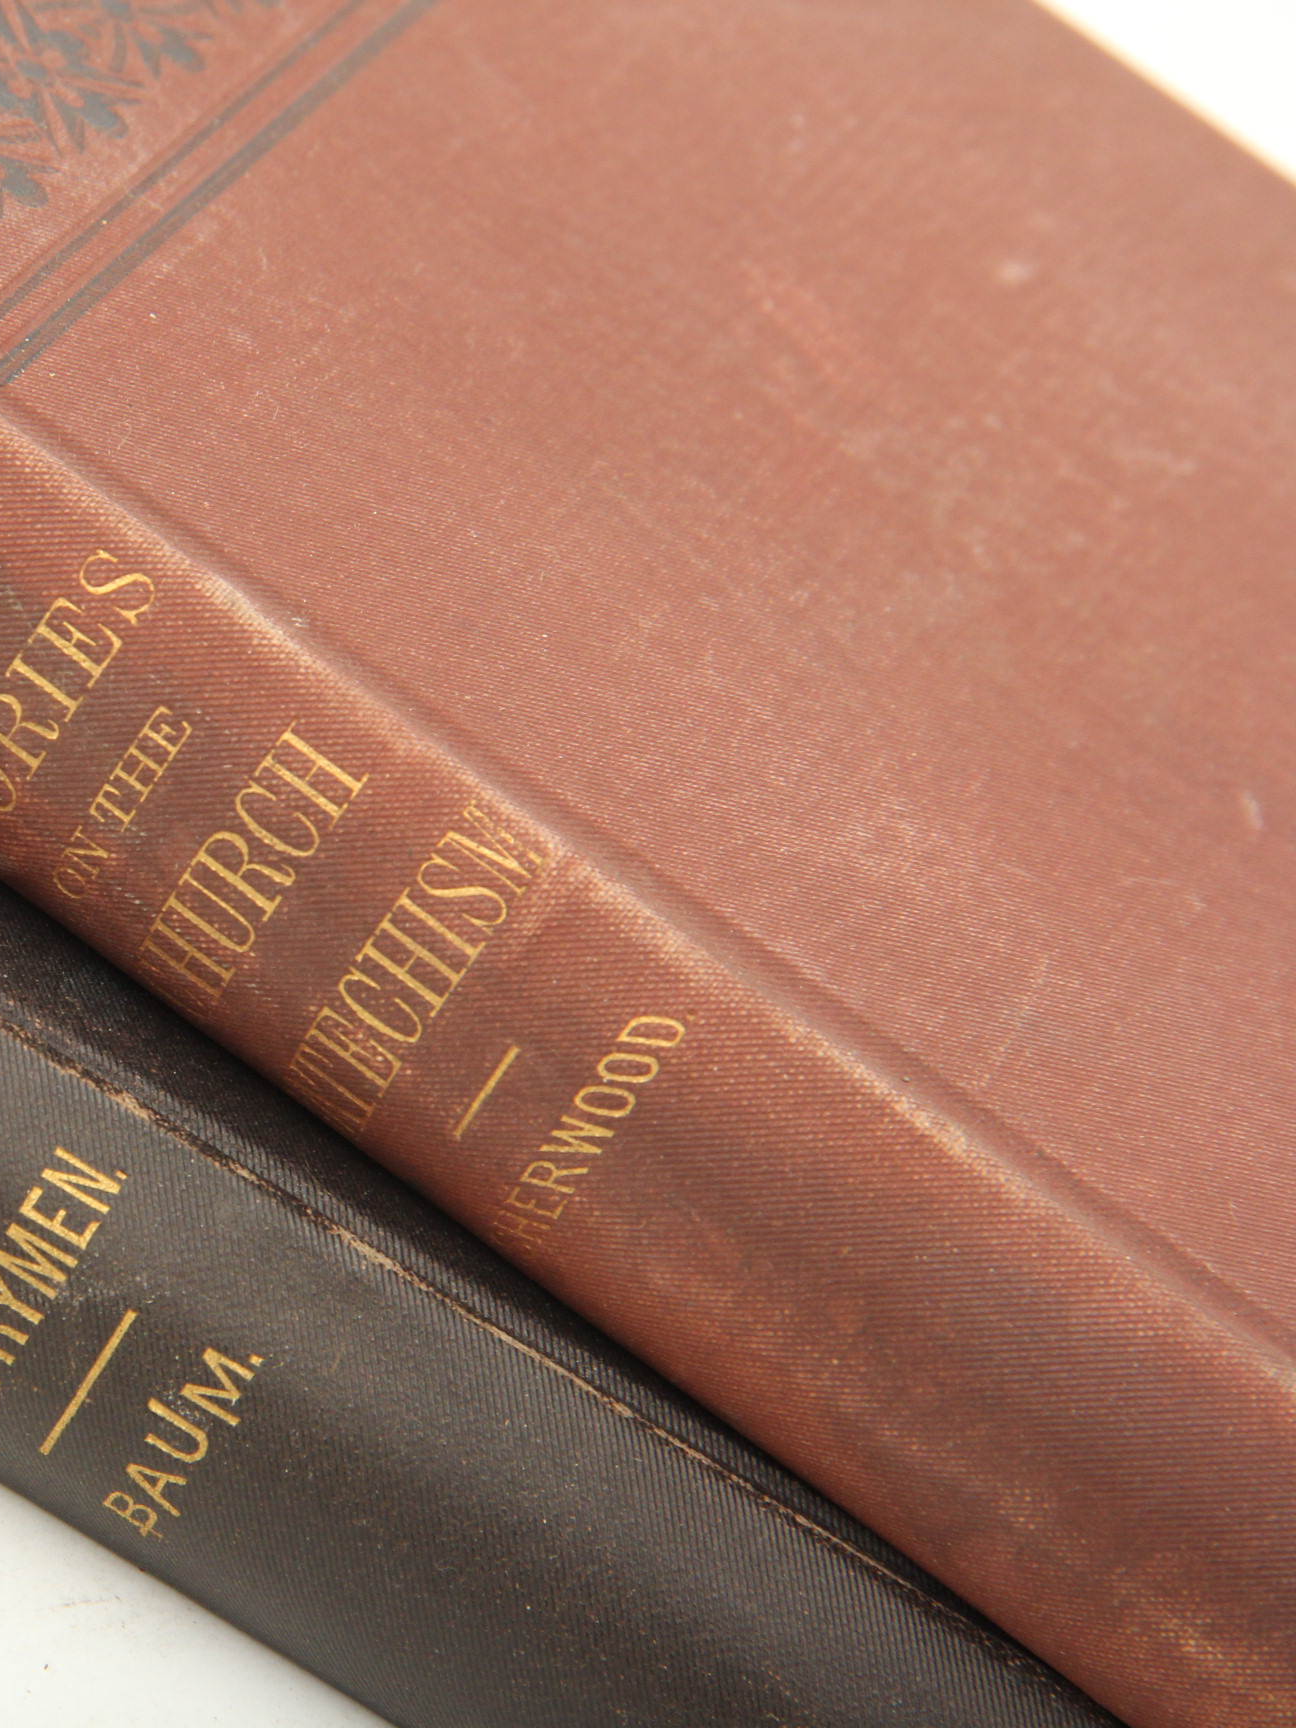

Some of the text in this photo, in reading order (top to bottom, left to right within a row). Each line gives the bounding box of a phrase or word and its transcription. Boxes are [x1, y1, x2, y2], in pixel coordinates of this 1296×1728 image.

[53, 706, 193, 898] ON THE
[282, 800, 545, 1133] TECHISM
[103, 1347, 264, 1539] BAUM.
